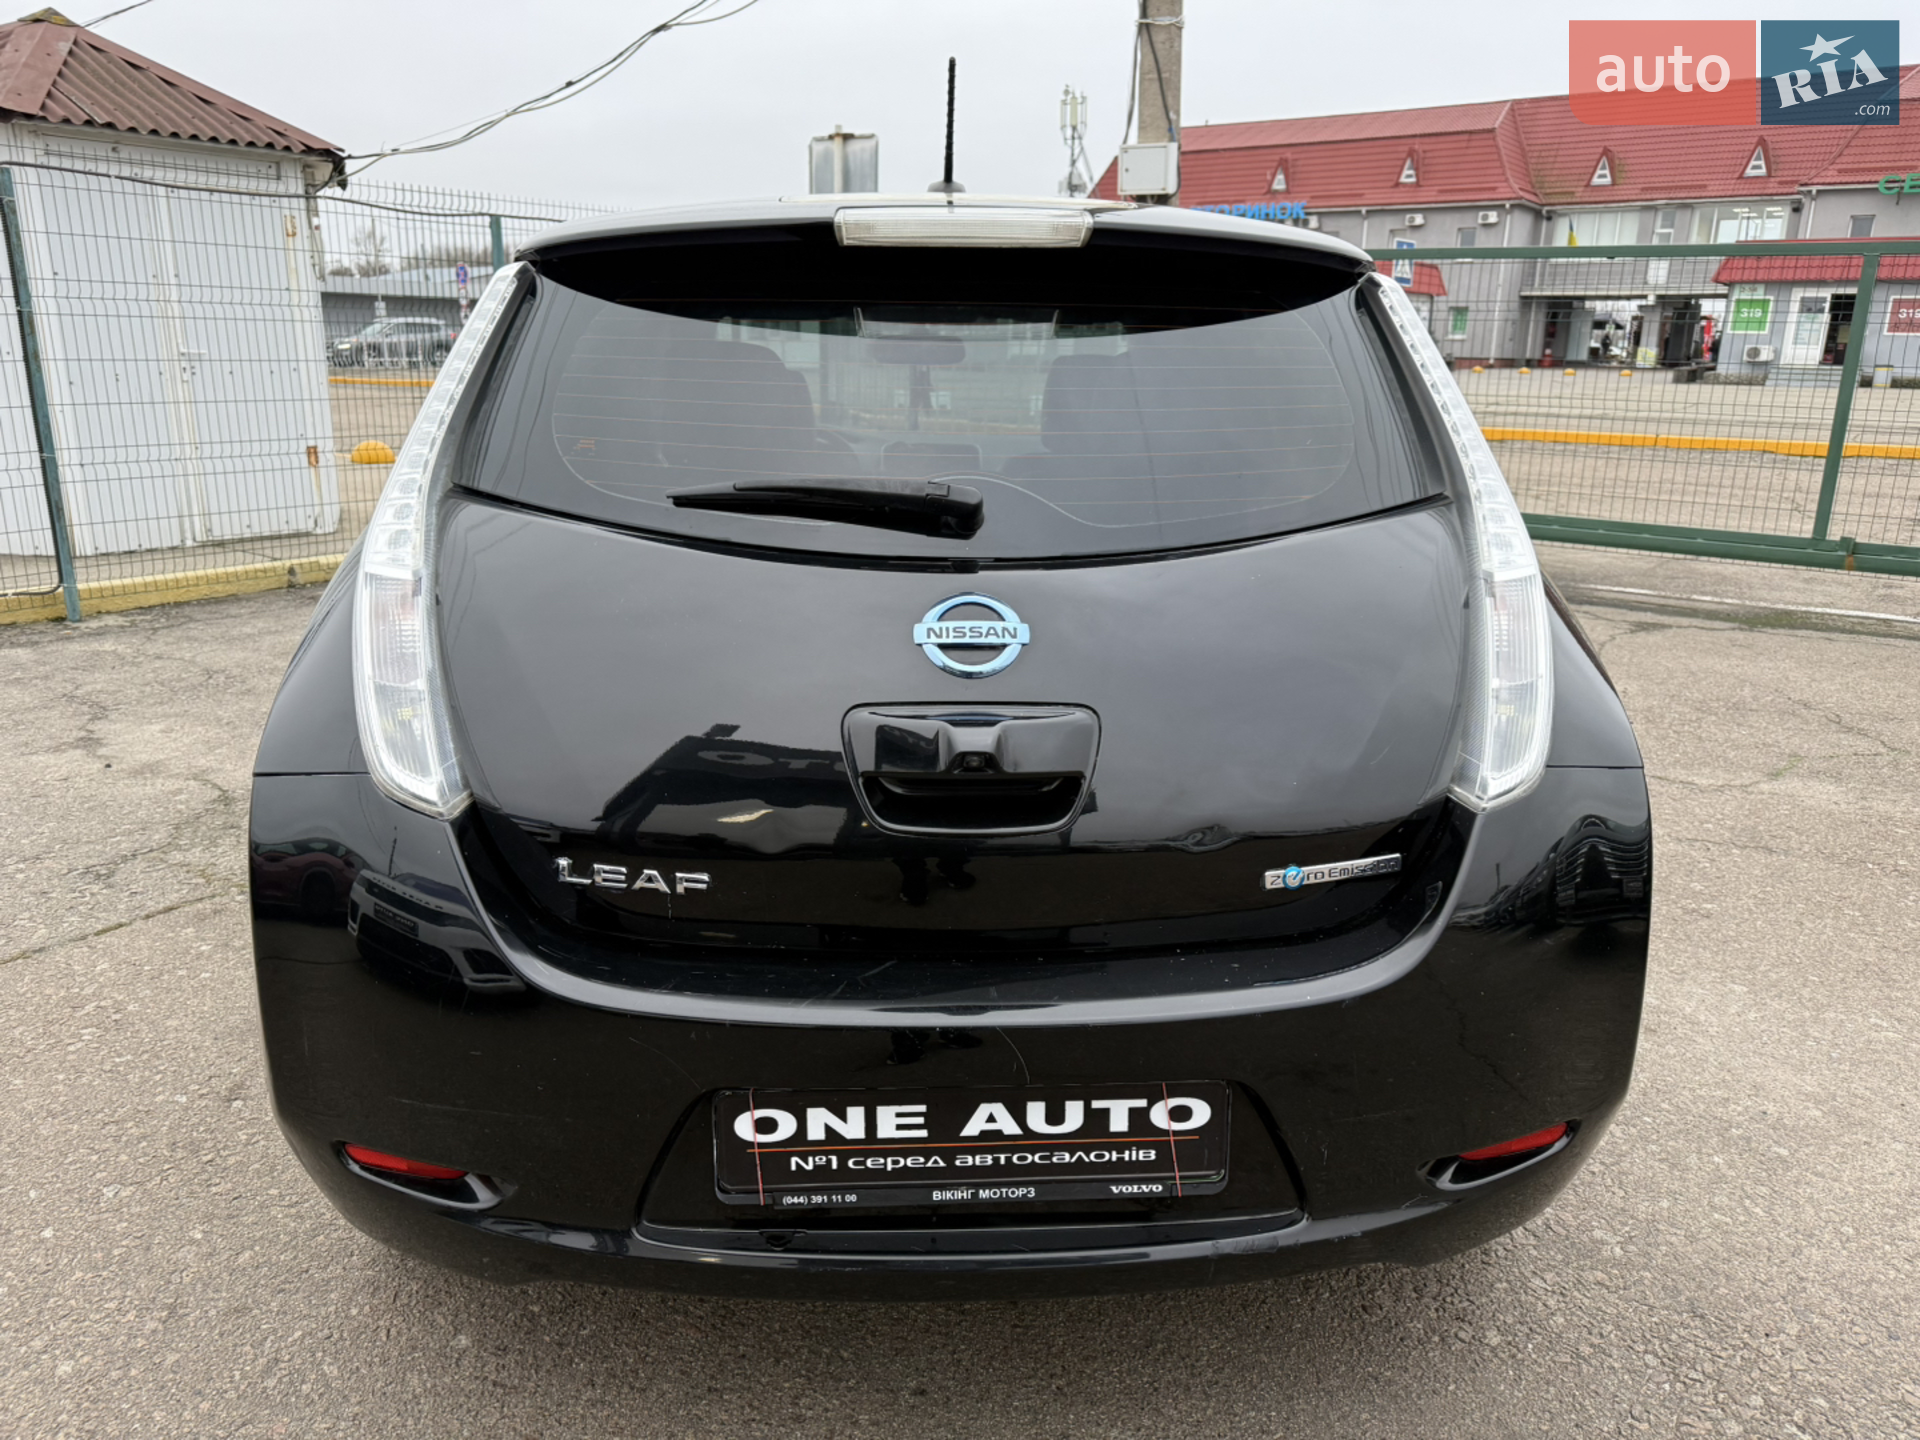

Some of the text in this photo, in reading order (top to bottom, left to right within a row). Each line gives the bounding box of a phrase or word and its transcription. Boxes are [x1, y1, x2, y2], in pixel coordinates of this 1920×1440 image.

[926, 626, 1018, 639] NISSAN
[557, 857, 711, 895] LEAF
[733, 1097, 1212, 1144] ONE AUTO
[847, 1156, 947, 1172] серед
[954, 1146, 1157, 1167] автосалонів
[932, 1189, 975, 1201] ВІКІНГ
[1109, 1183, 1163, 1194] VOLVO
[782, 1193, 857, 1206] (044) 391 11 00
